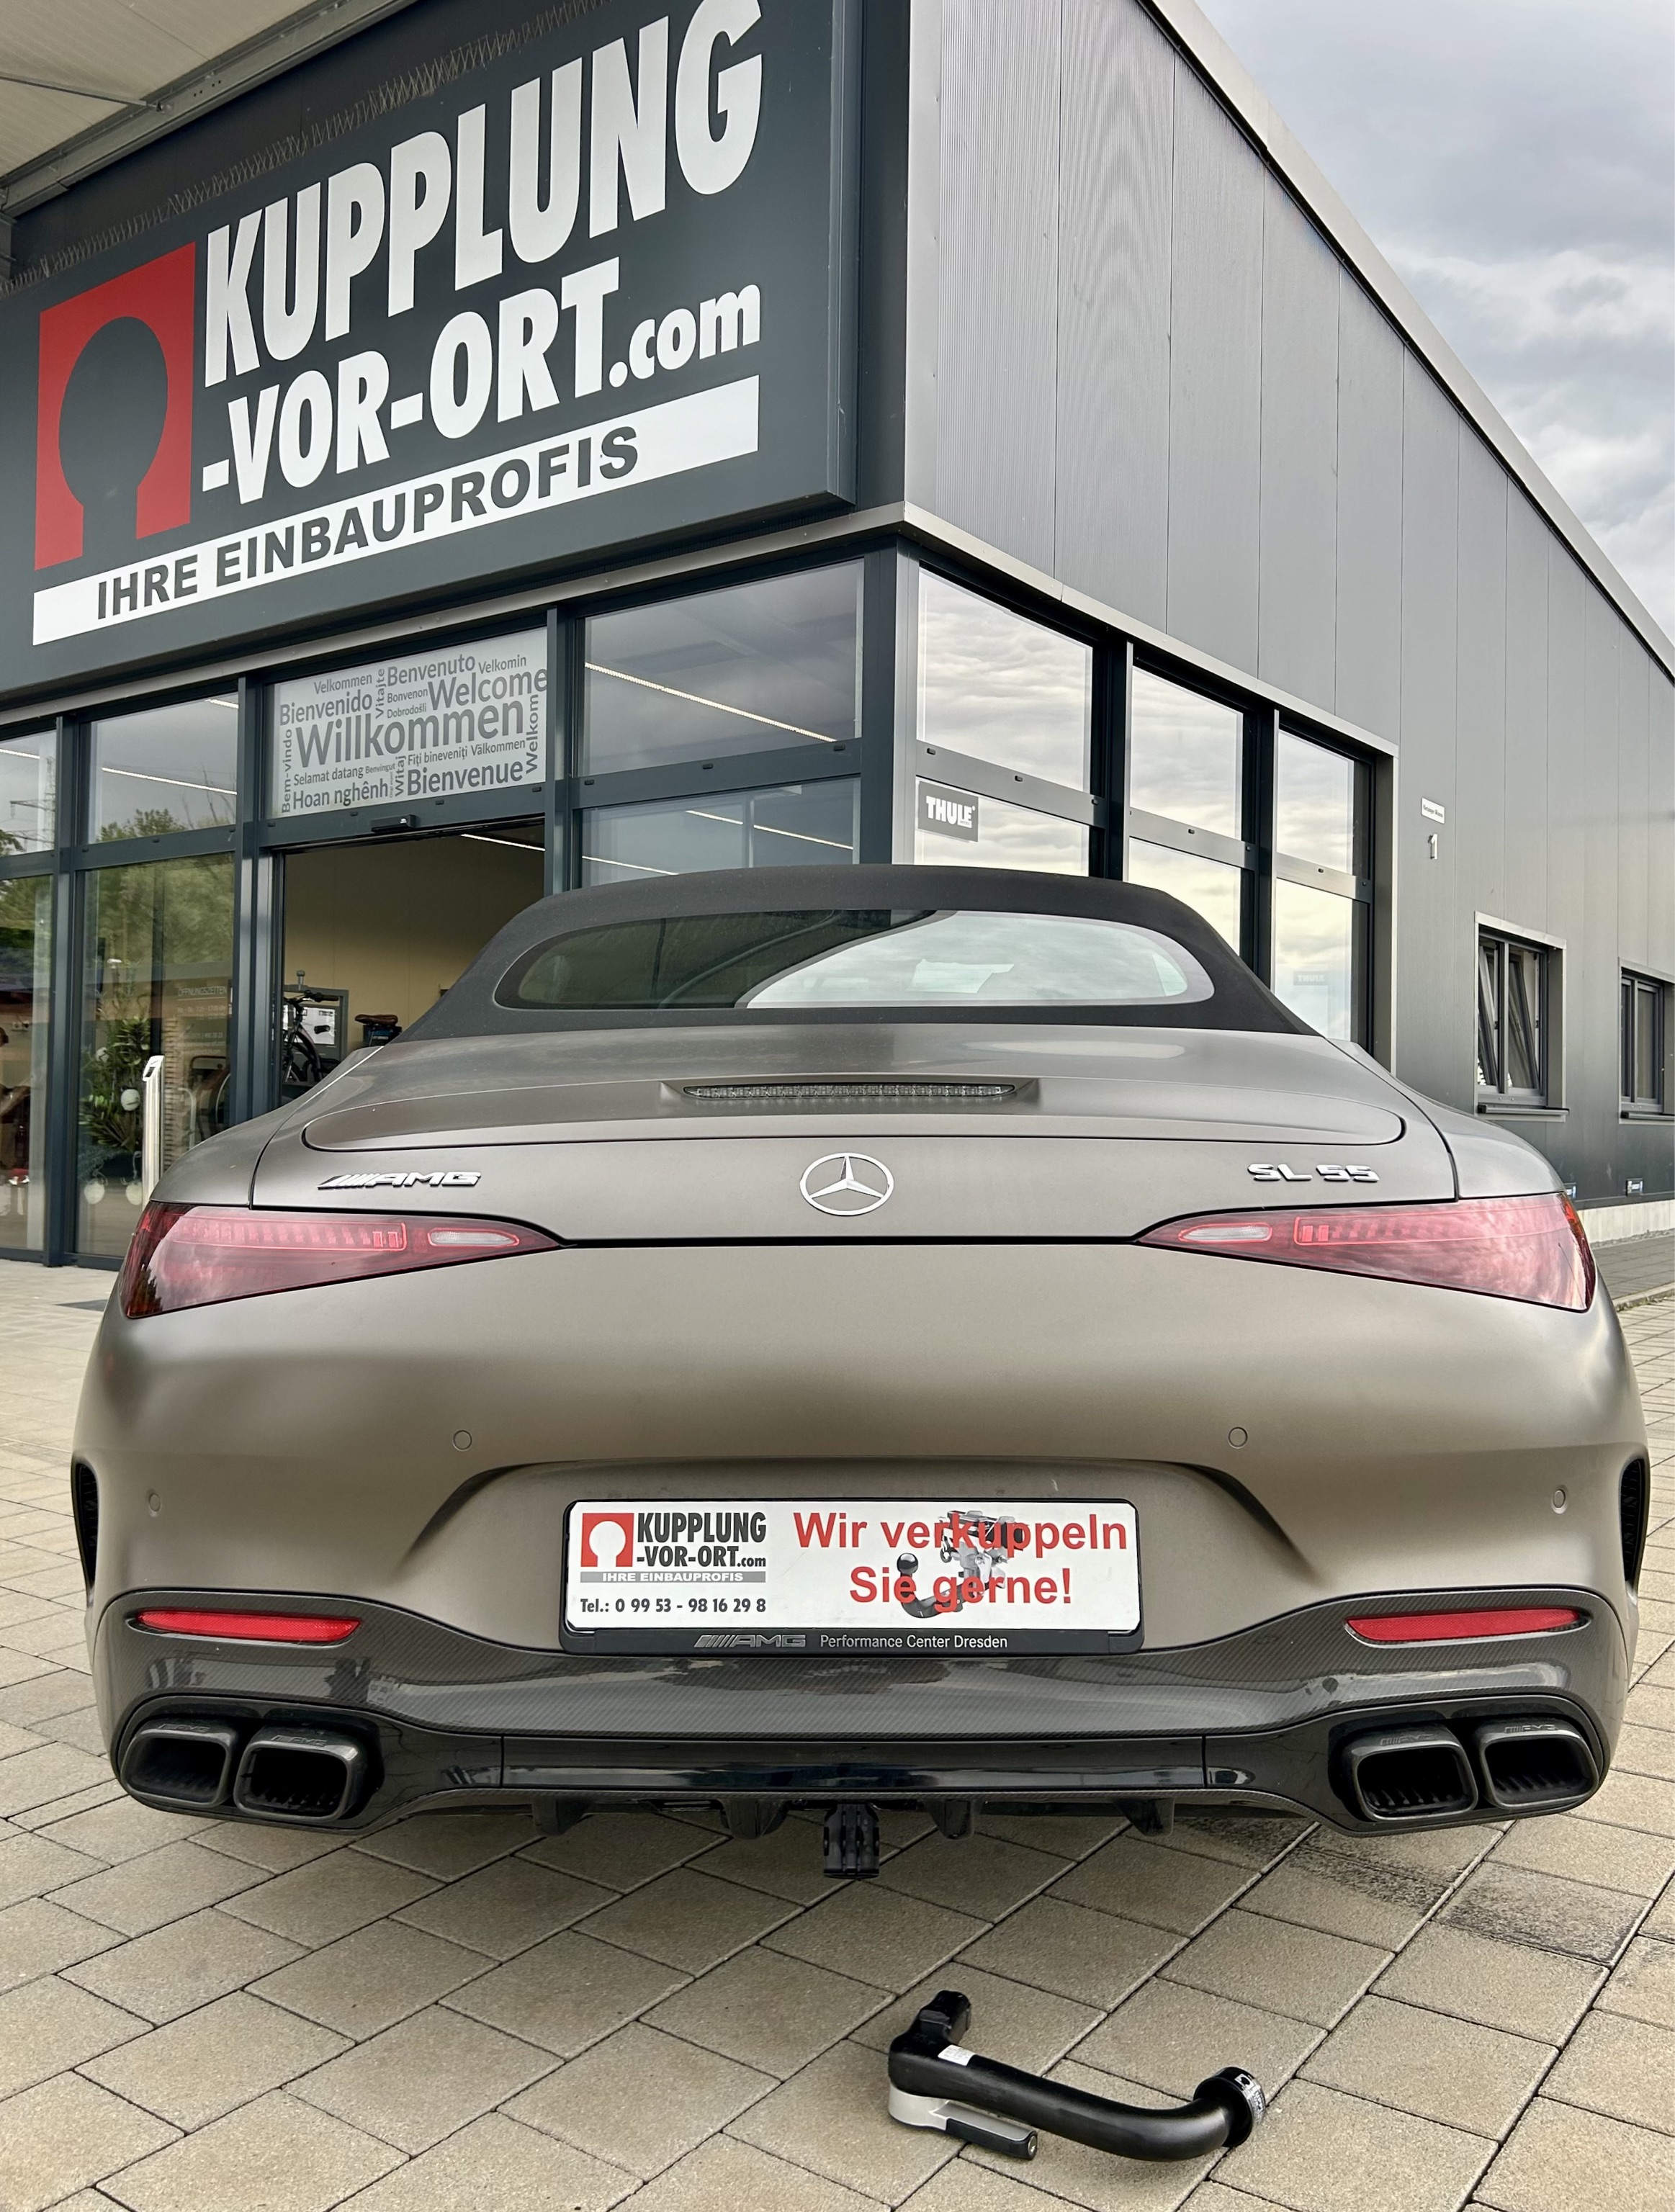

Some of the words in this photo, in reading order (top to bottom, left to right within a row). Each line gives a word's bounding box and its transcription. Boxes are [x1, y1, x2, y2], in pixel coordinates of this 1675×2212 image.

[205, 0, 763, 387] KUPPLUNG
[202, 257, 760, 504] -VOR-ORT.com
[98, 555, 198, 619] IHRE
[216, 426, 638, 587] EINBAUPROFIS
[387, 654, 475, 687] Benvenuto
[478, 654, 526, 674] Velkomin
[314, 674, 372, 695] Velkommen
[375, 668, 387, 719] Vitajte
[387, 688, 428, 703] Bonvenon
[428, 668, 547, 711] Welcome
[280, 689, 372, 726] Bienvenido
[387, 703, 427, 719] Dobrodošli
[295, 701, 524, 768] Willkommen
[471, 739, 526, 756] Välkommen
[526, 695, 539, 775] Welkom
[282, 729, 292, 813] Bem-vindo
[294, 770, 330, 786] Selamat
[332, 767, 364, 780] datang
[395, 755, 407, 796] Witaj
[407, 761, 524, 796] Bienvenue
[293, 791, 330, 809] Hoan
[334, 778, 388, 806] nghênh
[925, 795, 973, 828] THULE
[1429, 833, 1438, 860] 1
[365, 1172, 482, 1188] AMG
[1248, 1164, 1313, 1182] SL
[1316, 1164, 1380, 1183] 55
[637, 1511, 767, 1542] KUPPLUNG
[794, 1512, 868, 1548] Wir
[881, 1513, 1127, 1558] verkuppeln
[637, 1545, 767, 1568] -VOR-ORT.com
[603, 1573, 636, 1582] IHRE
[640, 1573, 744, 1582] EINBAUPROFIS
[850, 1565, 917, 1604] Sie
[933, 1568, 1071, 1613] gerne!
[580, 1598, 610, 1613] Tel.:
[615, 1598, 625, 1613] 0
[631, 1598, 650, 1613] 99
[655, 1598, 671, 1613] 53
[688, 1598, 708, 1613] 98
[713, 1598, 728, 1613] 16
[733, 1598, 751, 1613] 29
[756, 1598, 766, 1613] 8
[729, 1635, 807, 1648] AMG
[820, 1634, 903, 1649] Performance
[907, 1635, 949, 1648] Center
[954, 1635, 1008, 1648] Dresden
